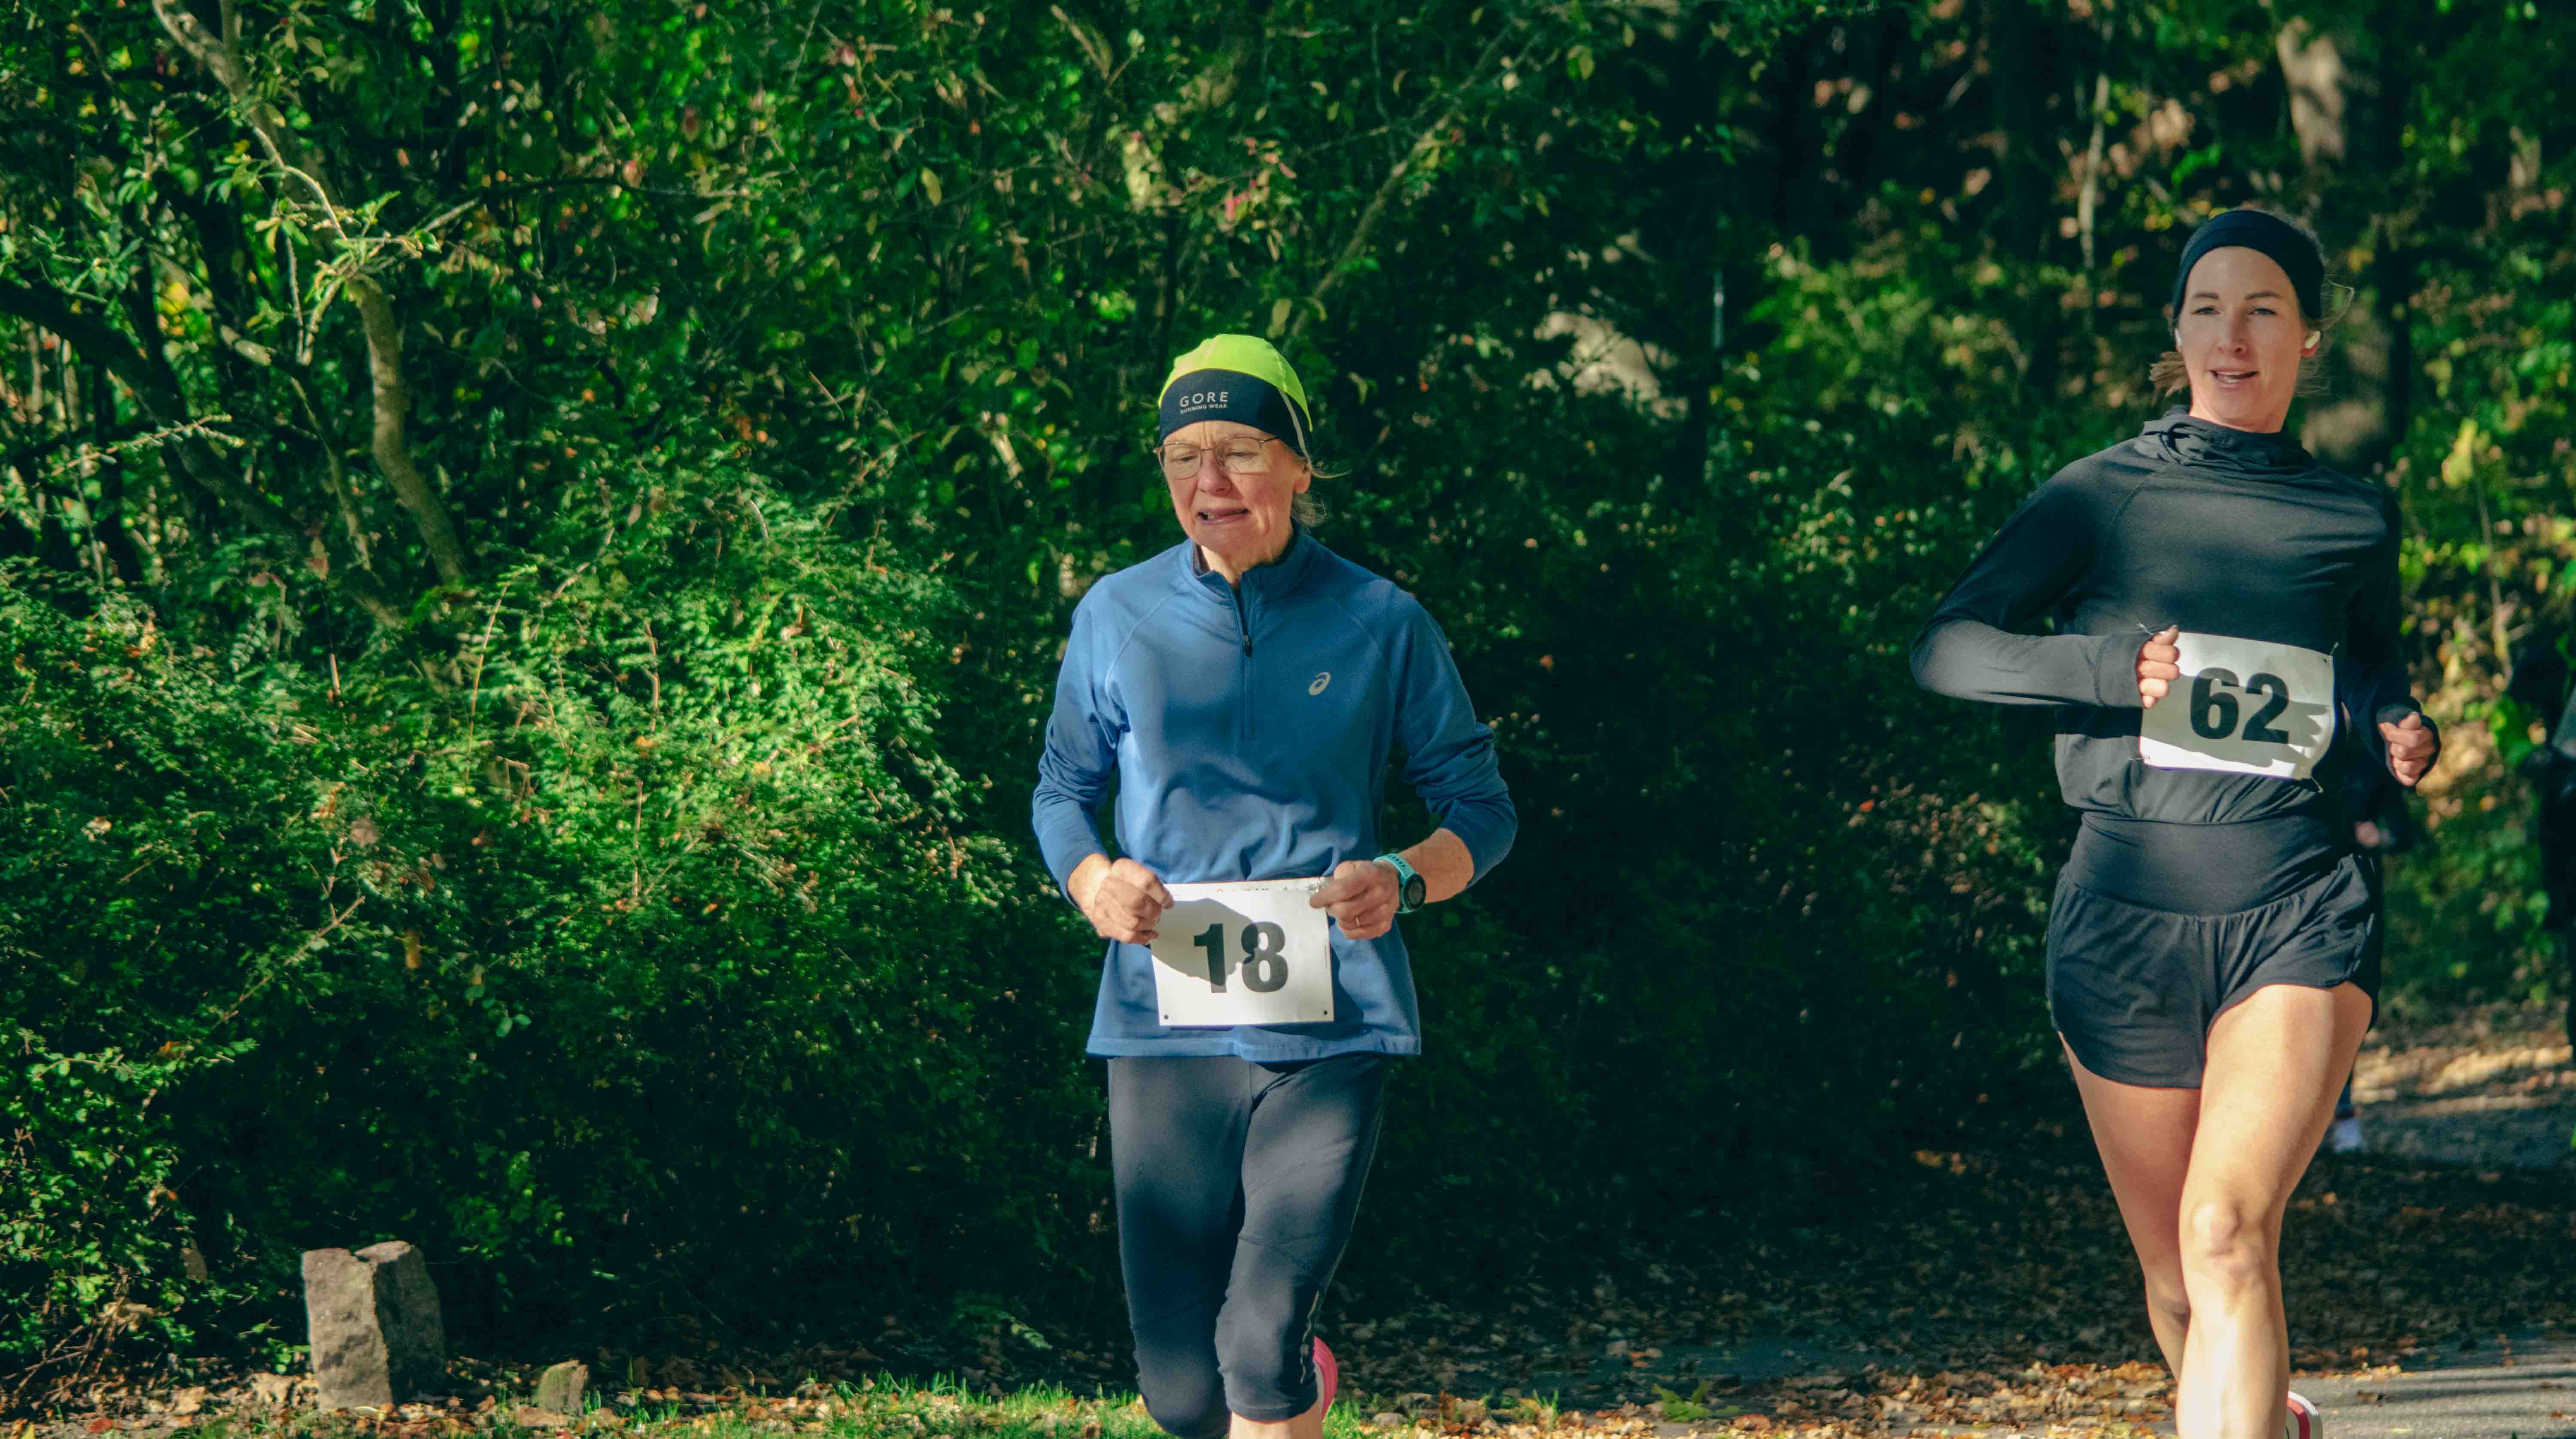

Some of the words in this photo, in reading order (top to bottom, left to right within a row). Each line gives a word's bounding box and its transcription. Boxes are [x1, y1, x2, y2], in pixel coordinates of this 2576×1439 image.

[1180, 392, 1228, 407] GORE
[2190, 667, 2289, 744] 62
[1194, 921, 1288, 993] 18
